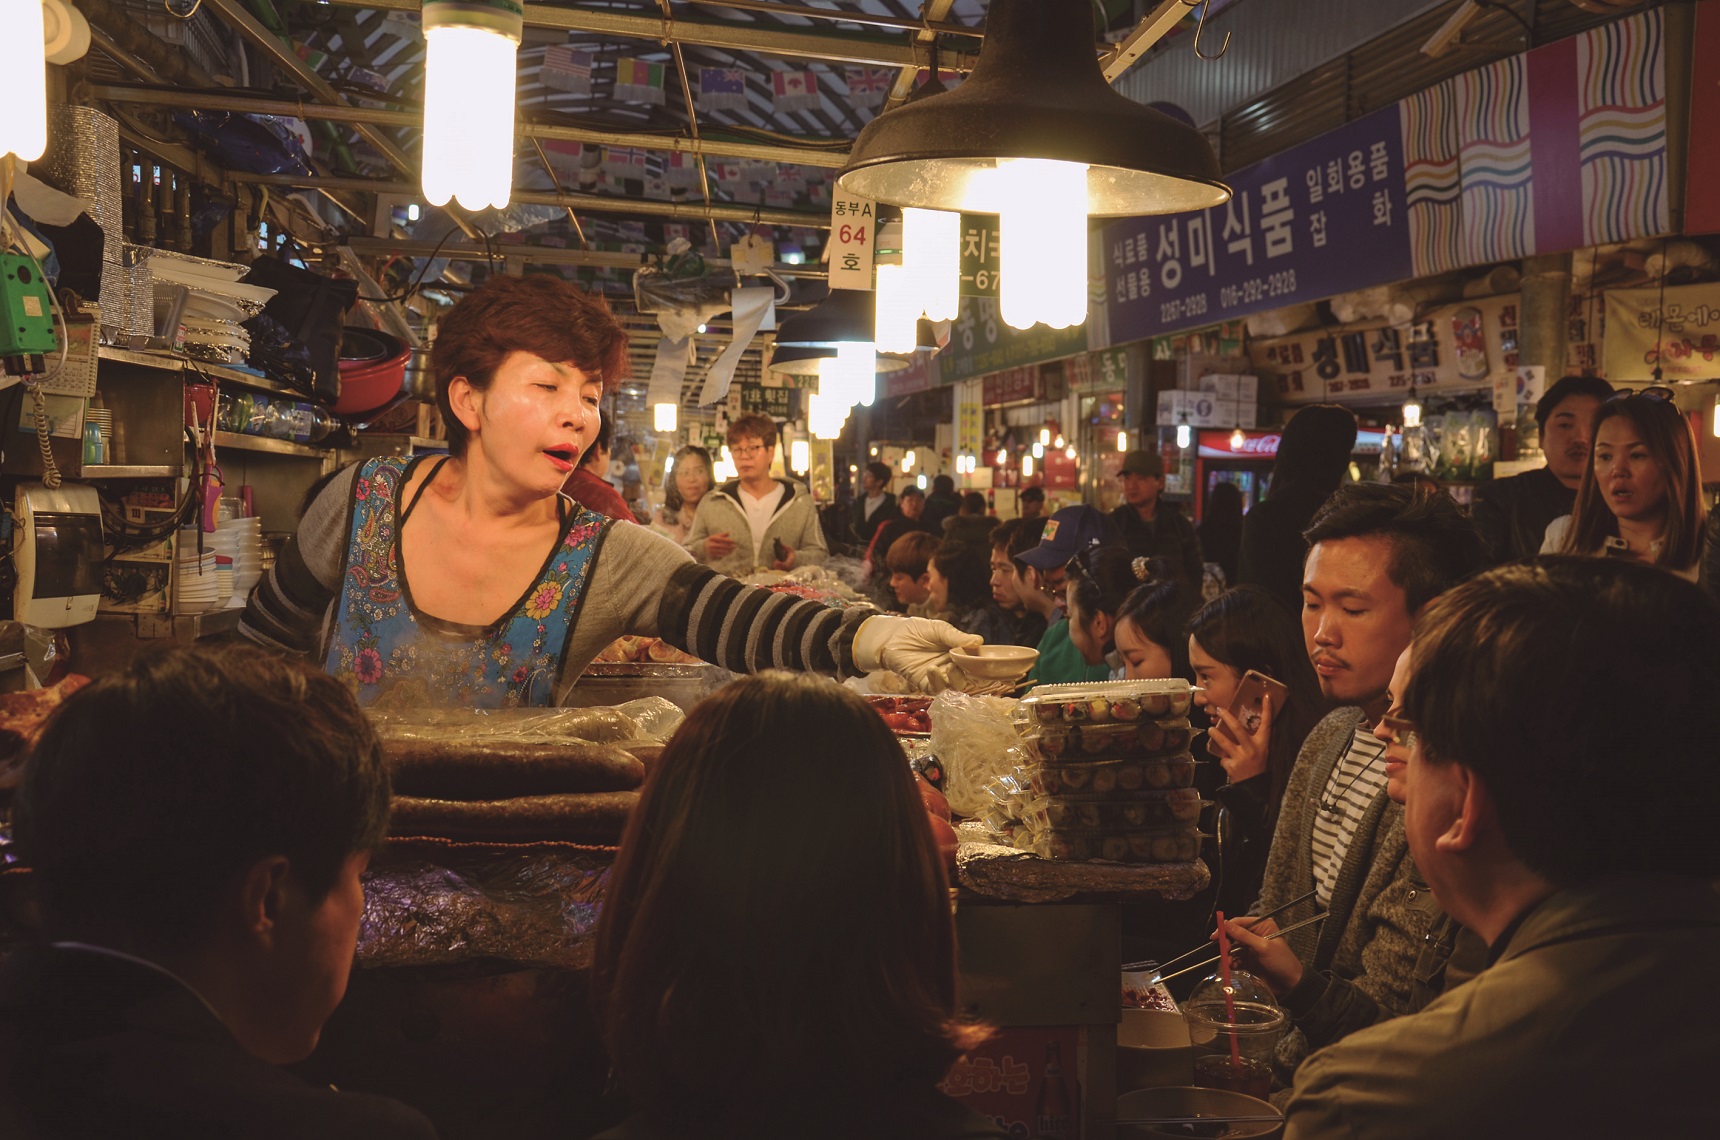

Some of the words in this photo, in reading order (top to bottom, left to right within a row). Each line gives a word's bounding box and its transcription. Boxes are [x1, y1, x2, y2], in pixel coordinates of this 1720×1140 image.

[1305, 141, 1389, 204] 일회용품
[835, 201, 872, 218] 동부A
[839, 224, 866, 246] 64
[1156, 177, 1294, 290] 성미식품
[840, 253, 861, 271] 호
